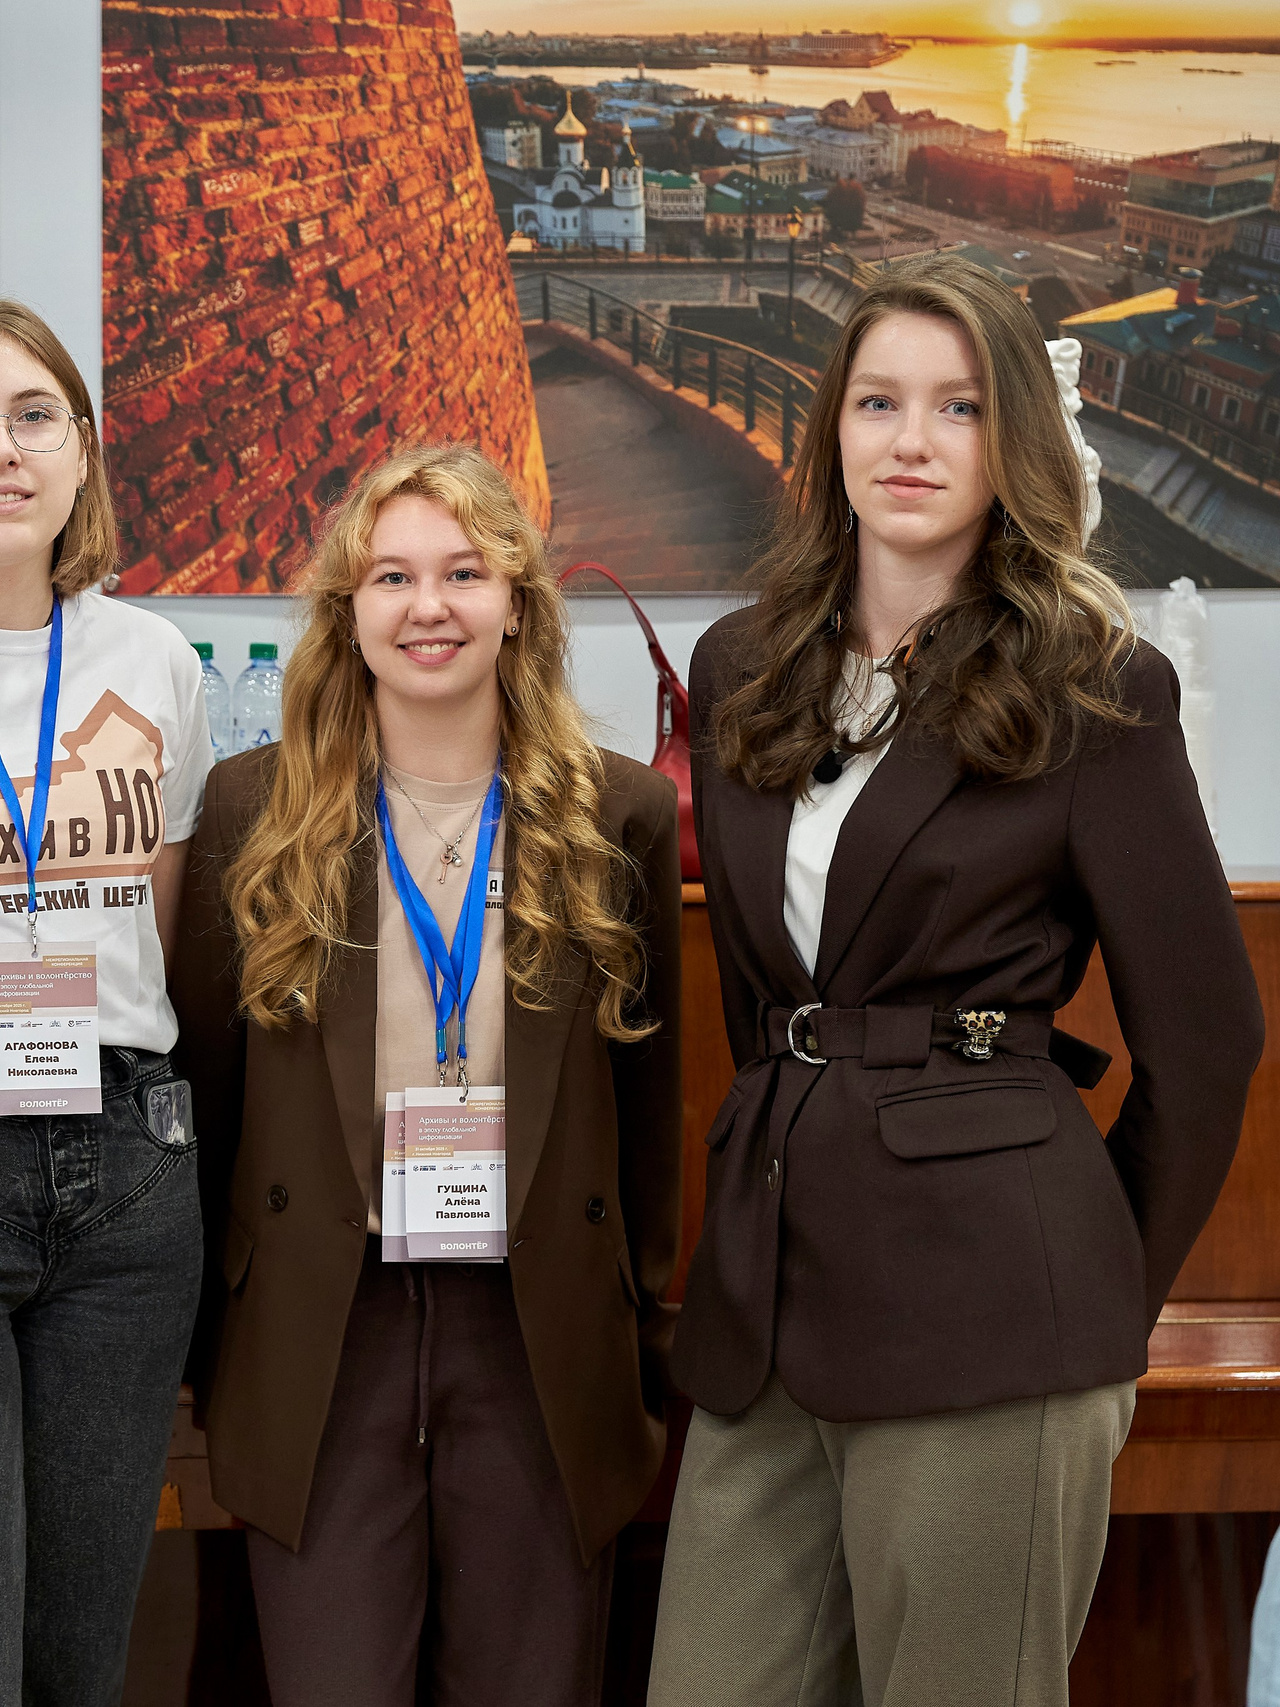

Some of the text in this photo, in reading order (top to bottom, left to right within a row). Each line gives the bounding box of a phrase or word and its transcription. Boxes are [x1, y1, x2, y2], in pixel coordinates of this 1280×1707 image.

[36, 971, 93, 981] волонтёрство
[4, 1041, 79, 1051] АГАФОНОВА
[25, 1055, 59, 1063] Елена
[7, 1068, 78, 1077] Николаевна
[20, 1098, 69, 1108] ВОЛОНТЁР
[419, 1117, 450, 1126] Архивы
[437, 1184, 488, 1194] ГУЩИНА
[445, 1197, 481, 1206] Алёна
[435, 1211, 490, 1219] Павловна
[440, 1242, 488, 1250] ВОЛОНТЁР
